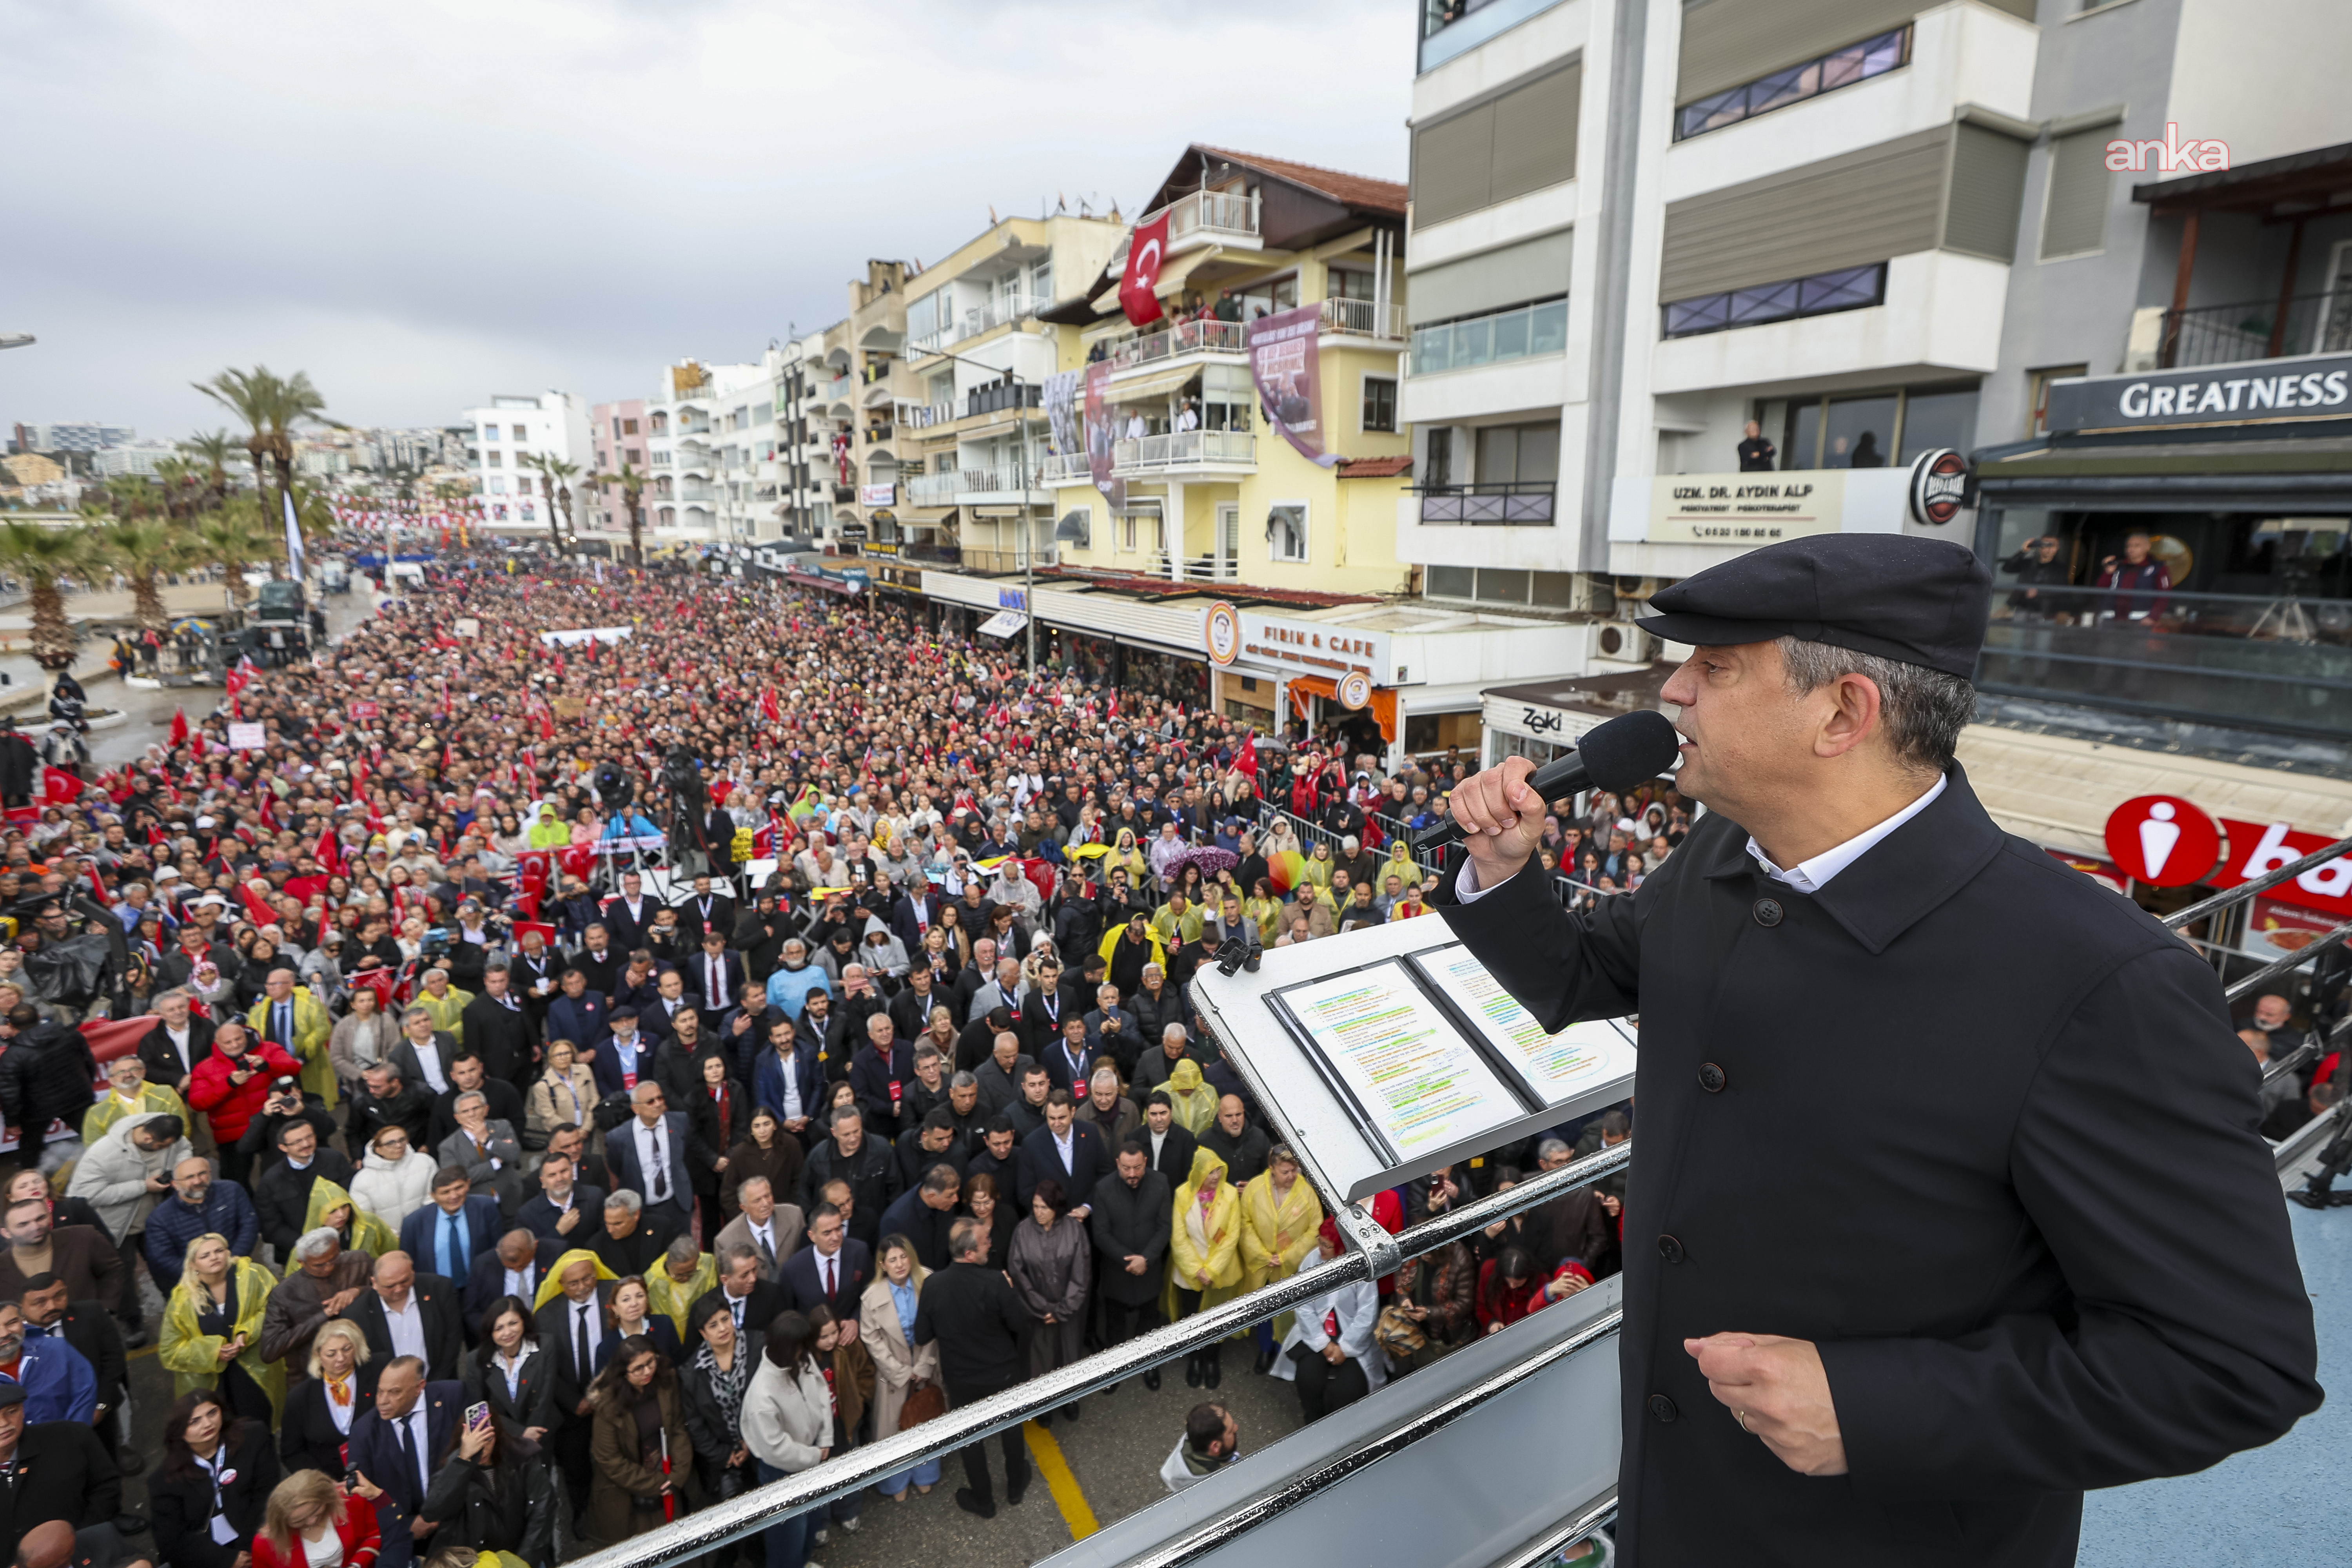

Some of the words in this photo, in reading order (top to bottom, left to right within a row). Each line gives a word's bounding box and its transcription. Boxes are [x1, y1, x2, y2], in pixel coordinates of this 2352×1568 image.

[2120, 370, 2348, 418] GREATNESS
[1674, 487, 1704, 499] UZM.
[1710, 486, 1731, 498] DR.
[1737, 485, 1780, 498] AYDIN
[1784, 484, 1813, 497] ALP
[1265, 626, 1305, 645] FIRIN
[1312, 633, 1320, 648] &
[1330, 636, 1373, 657] CAFE
[1523, 707, 1562, 734] Zeki
[2240, 822, 2352, 898] ba
